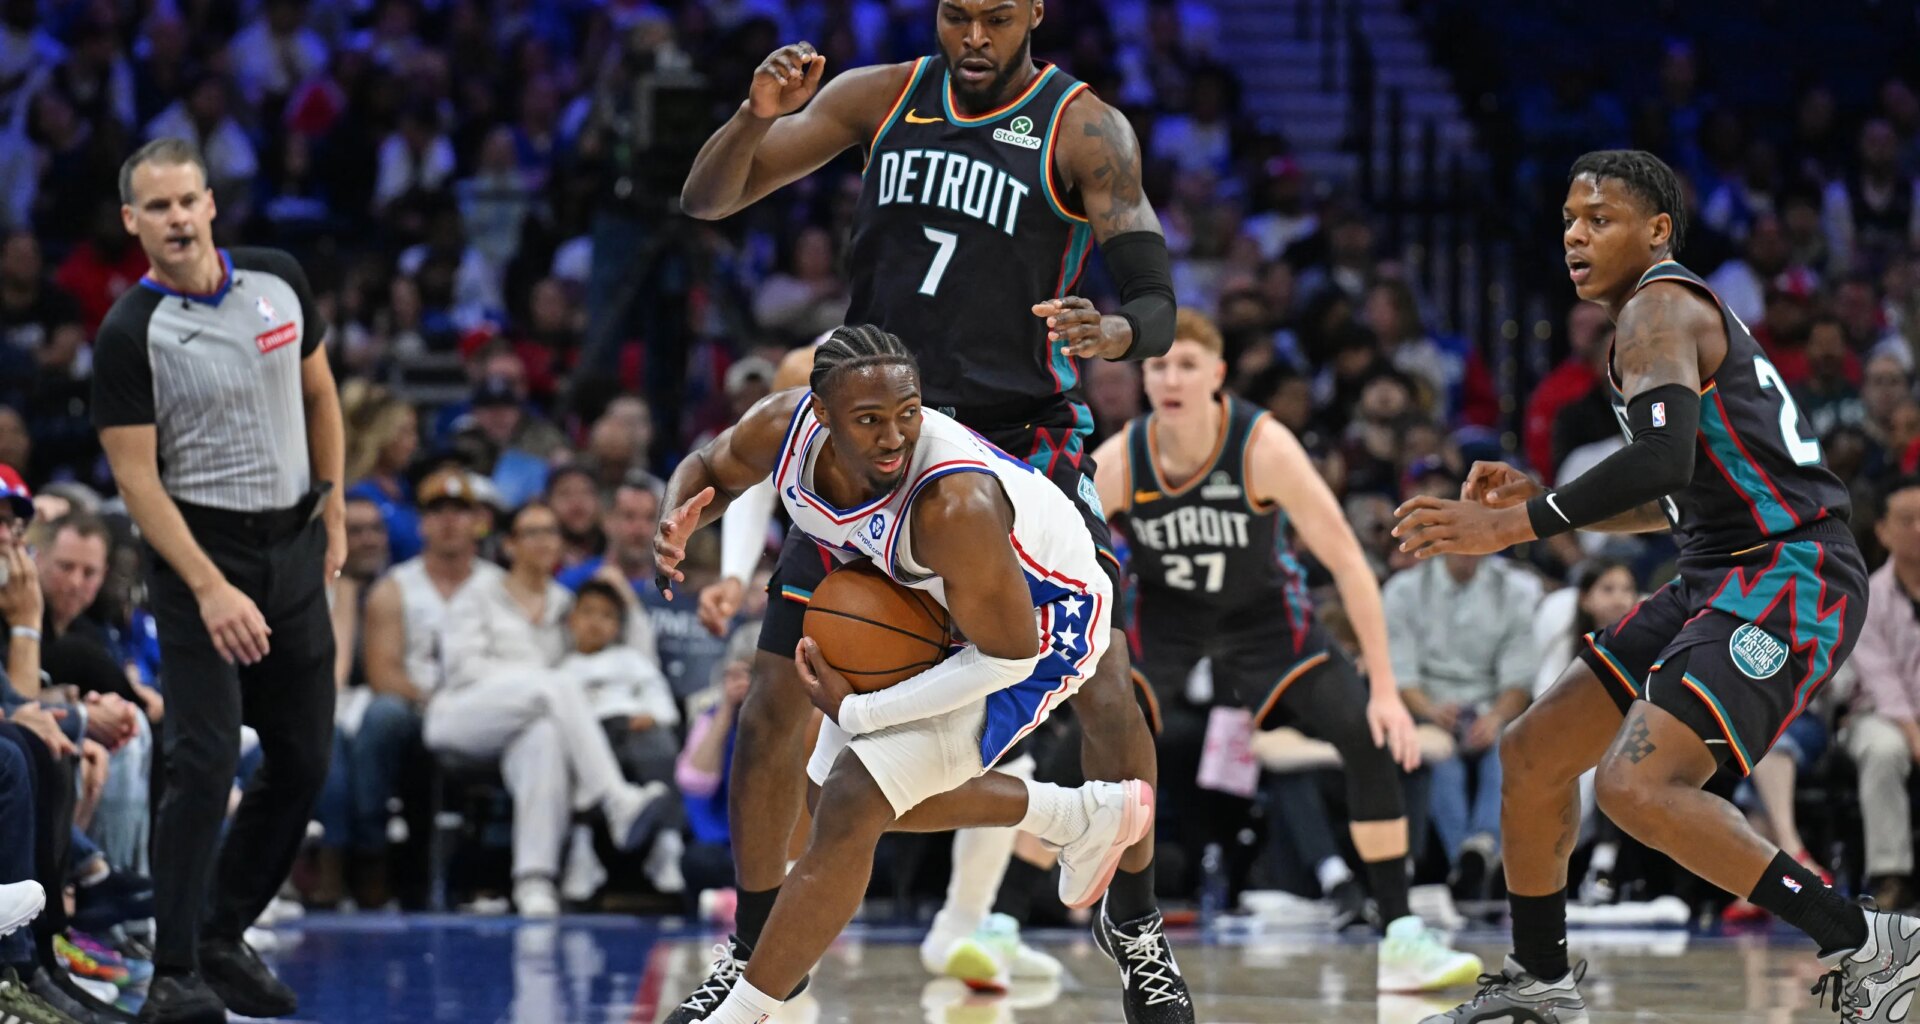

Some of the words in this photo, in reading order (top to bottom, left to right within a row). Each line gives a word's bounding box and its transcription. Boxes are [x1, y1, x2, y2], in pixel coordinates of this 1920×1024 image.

[994, 130, 1040, 148] StockX
[878, 149, 1030, 237] DETROIT
[918, 225, 959, 296] 7
[857, 530, 884, 558] crypto.com
[1161, 552, 1226, 592] 27
[1738, 634, 1774, 670] PISTONS
[1748, 625, 1784, 660] DETROIT
